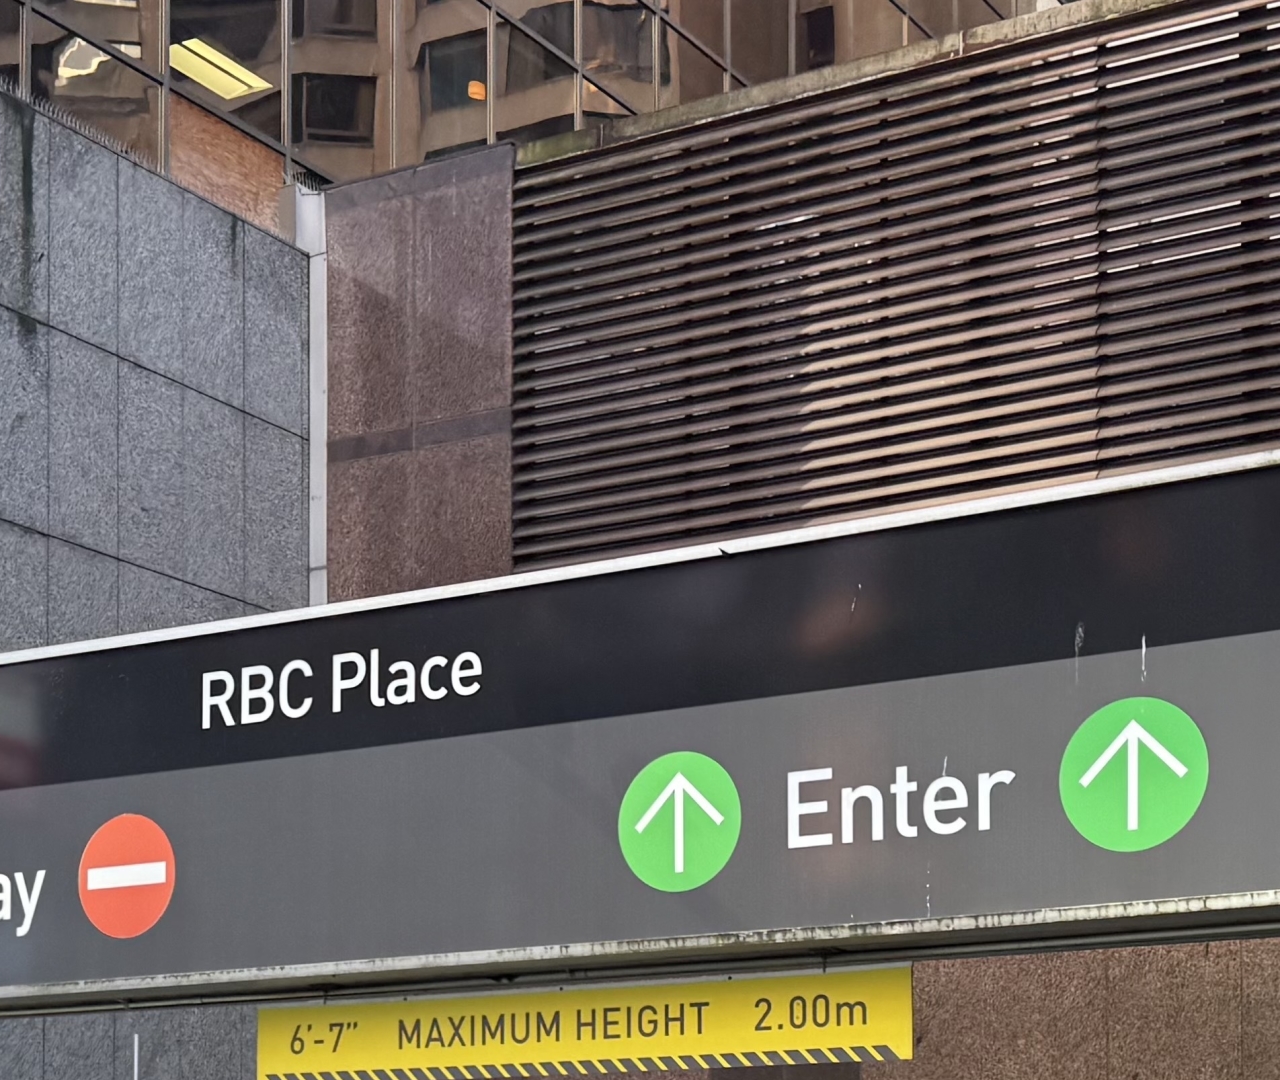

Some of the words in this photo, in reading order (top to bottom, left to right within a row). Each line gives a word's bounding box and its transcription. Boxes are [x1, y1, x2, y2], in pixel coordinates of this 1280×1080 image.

[201, 660, 314, 729] RBC
[331, 648, 483, 713] Place
[787, 766, 1015, 849] Enter
[398, 1011, 561, 1049] MAXIMUM
[576, 1002, 710, 1041] HEIGHT
[754, 994, 868, 1032] 2.00m
